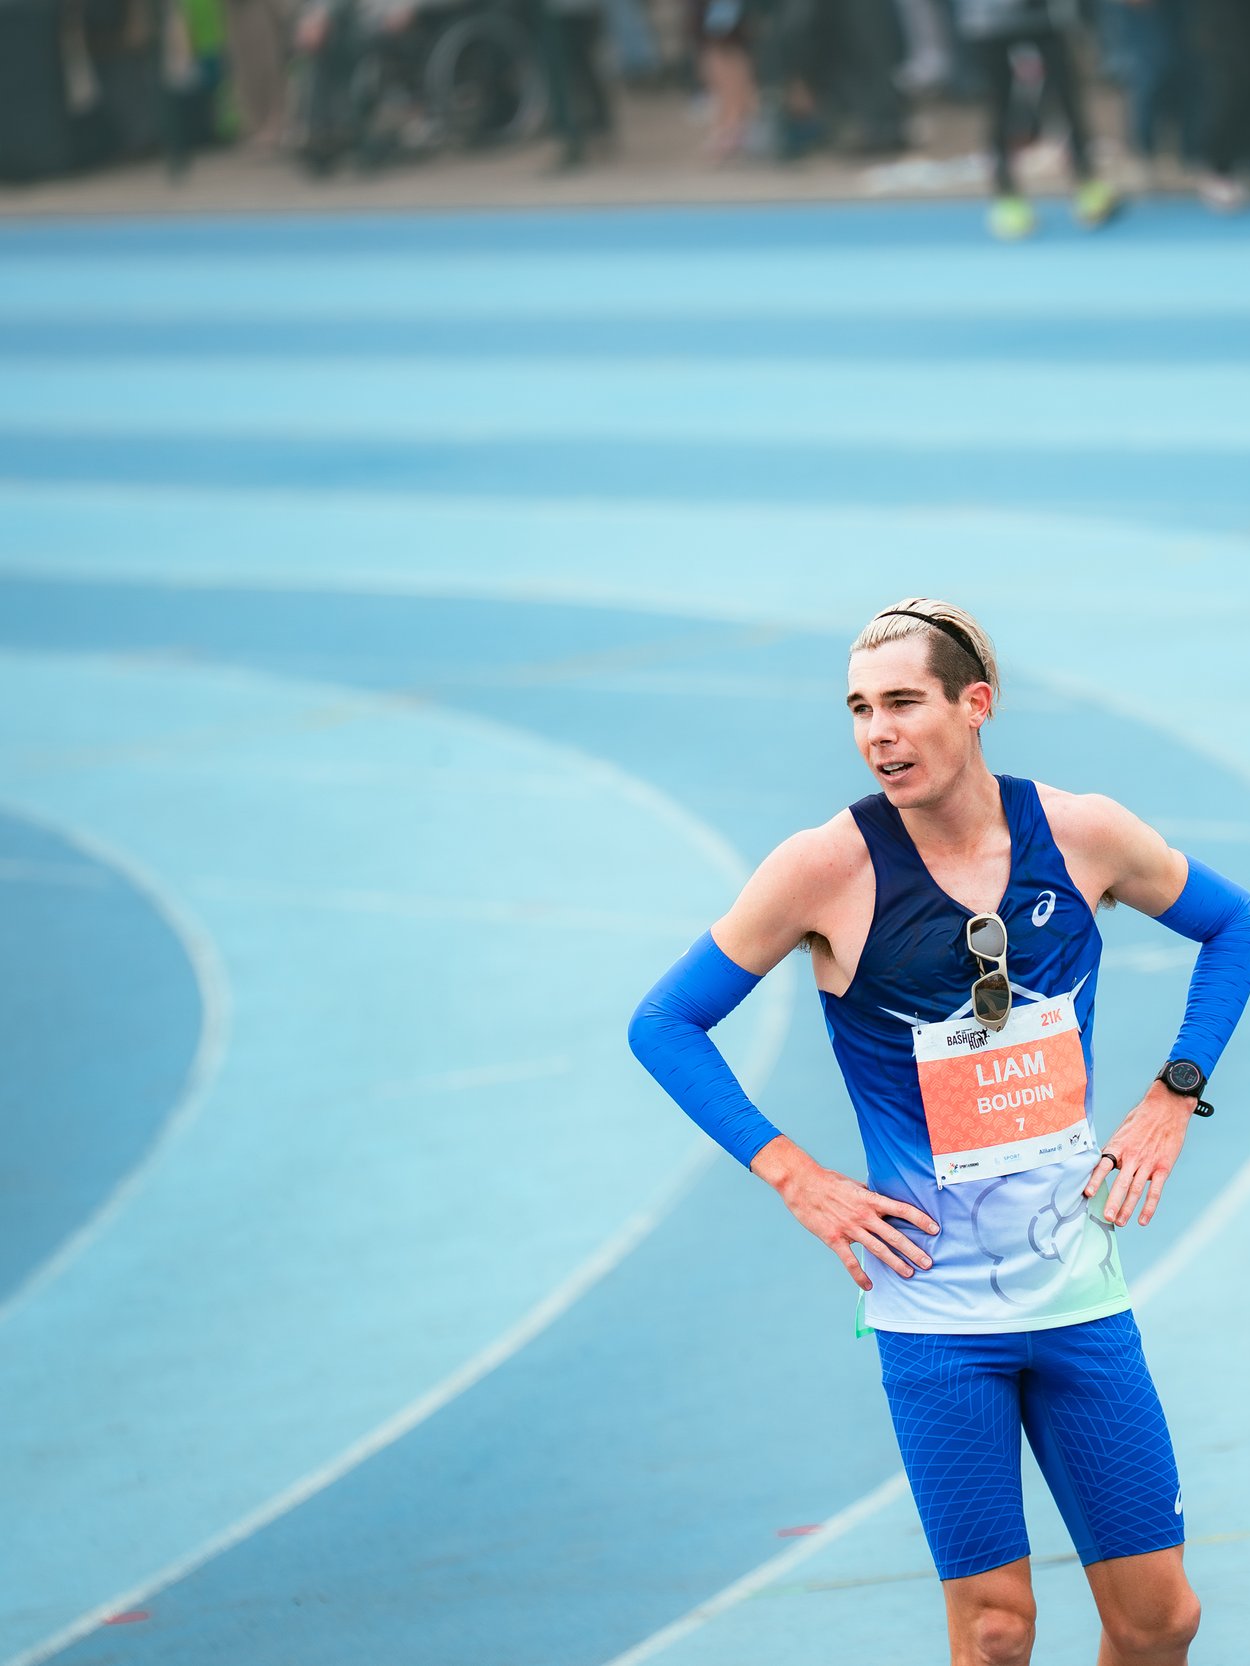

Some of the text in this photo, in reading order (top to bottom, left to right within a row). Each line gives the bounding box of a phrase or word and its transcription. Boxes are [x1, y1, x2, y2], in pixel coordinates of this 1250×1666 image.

[1040, 1008, 1062, 1027] 21K
[975, 1050, 1046, 1087] LIAM
[977, 1083, 1054, 1114] BOUDIN
[1015, 1117, 1025, 1132] 7
